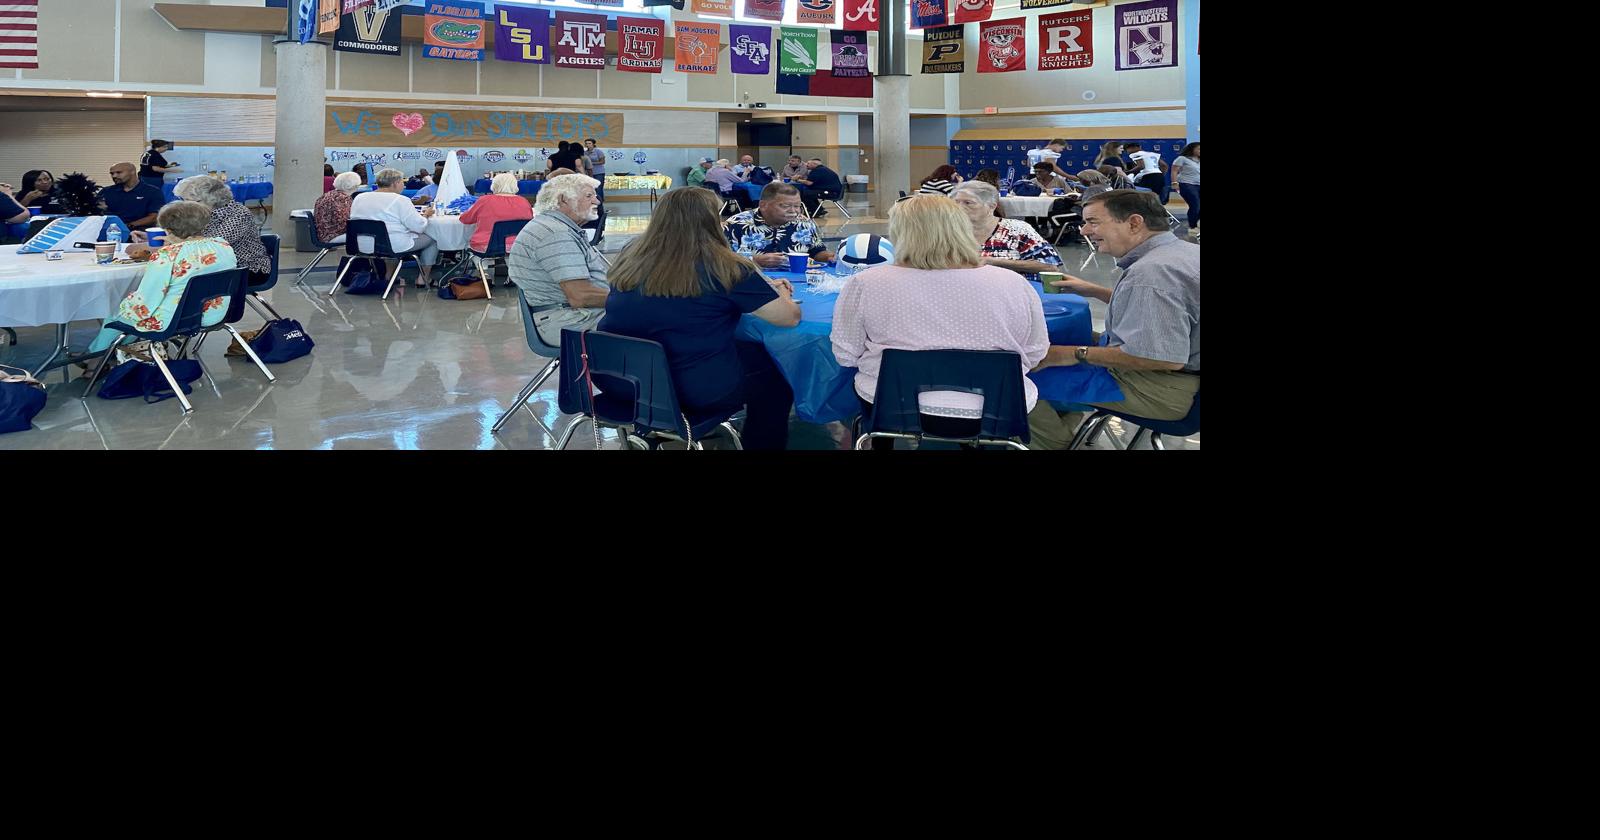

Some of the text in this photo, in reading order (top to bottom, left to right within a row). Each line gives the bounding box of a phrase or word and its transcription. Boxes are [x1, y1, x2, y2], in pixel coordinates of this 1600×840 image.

[430, 4, 480, 18] FLORIDA
[1123, 7, 1168, 17] NORTHWESTERN
[1041, 15, 1090, 25] RUTGERS
[1123, 13, 1168, 25] WILDCATS
[623, 24, 660, 36] LAMAR
[927, 30, 960, 40] PURDUE
[1045, 25, 1084, 54] R
[338, 41, 398, 52] COMMODORES
[928, 42, 960, 62] P
[428, 47, 479, 60] GATORS
[1041, 53, 1091, 62] SCARLET
[557, 56, 605, 66] AGGIES
[620, 56, 663, 68] CARDINALS
[1041, 60, 1091, 68] KNIGHTS
[677, 64, 717, 73] BEARKATS
[331, 110, 382, 136] We
[431, 112, 481, 137] Our
